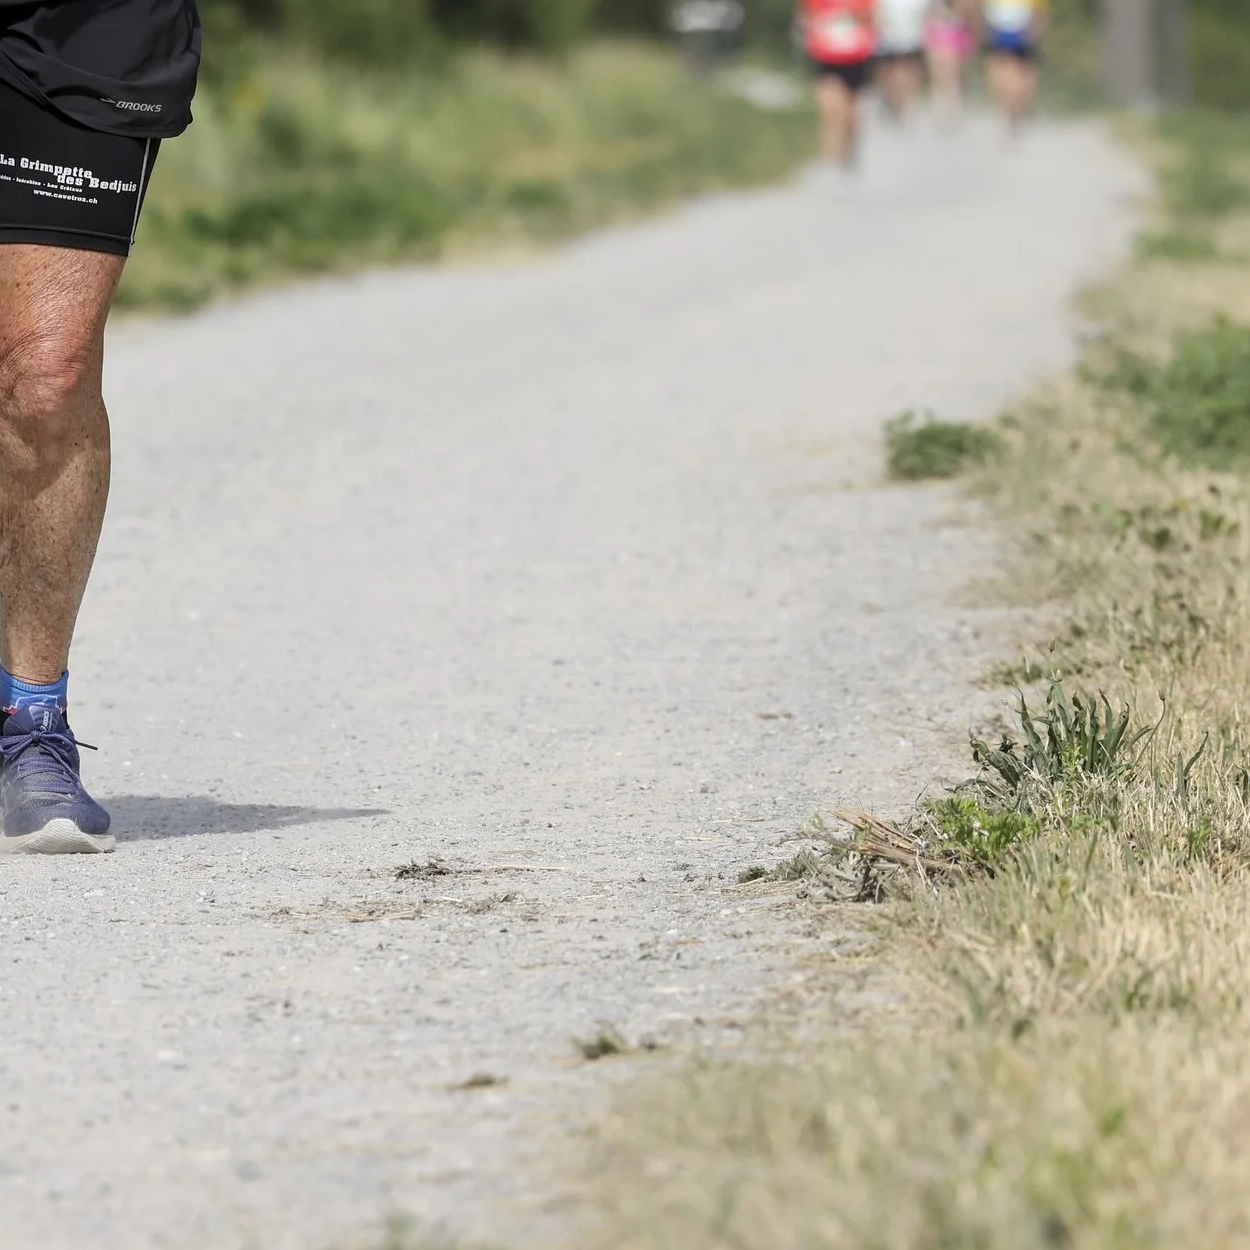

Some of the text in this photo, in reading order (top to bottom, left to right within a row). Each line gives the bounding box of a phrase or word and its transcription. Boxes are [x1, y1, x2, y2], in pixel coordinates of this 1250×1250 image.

[116, 101, 162, 112] BROOKS
[0, 153, 93, 179] La Grimpette
[56, 172, 137, 193] des Bedjuis
